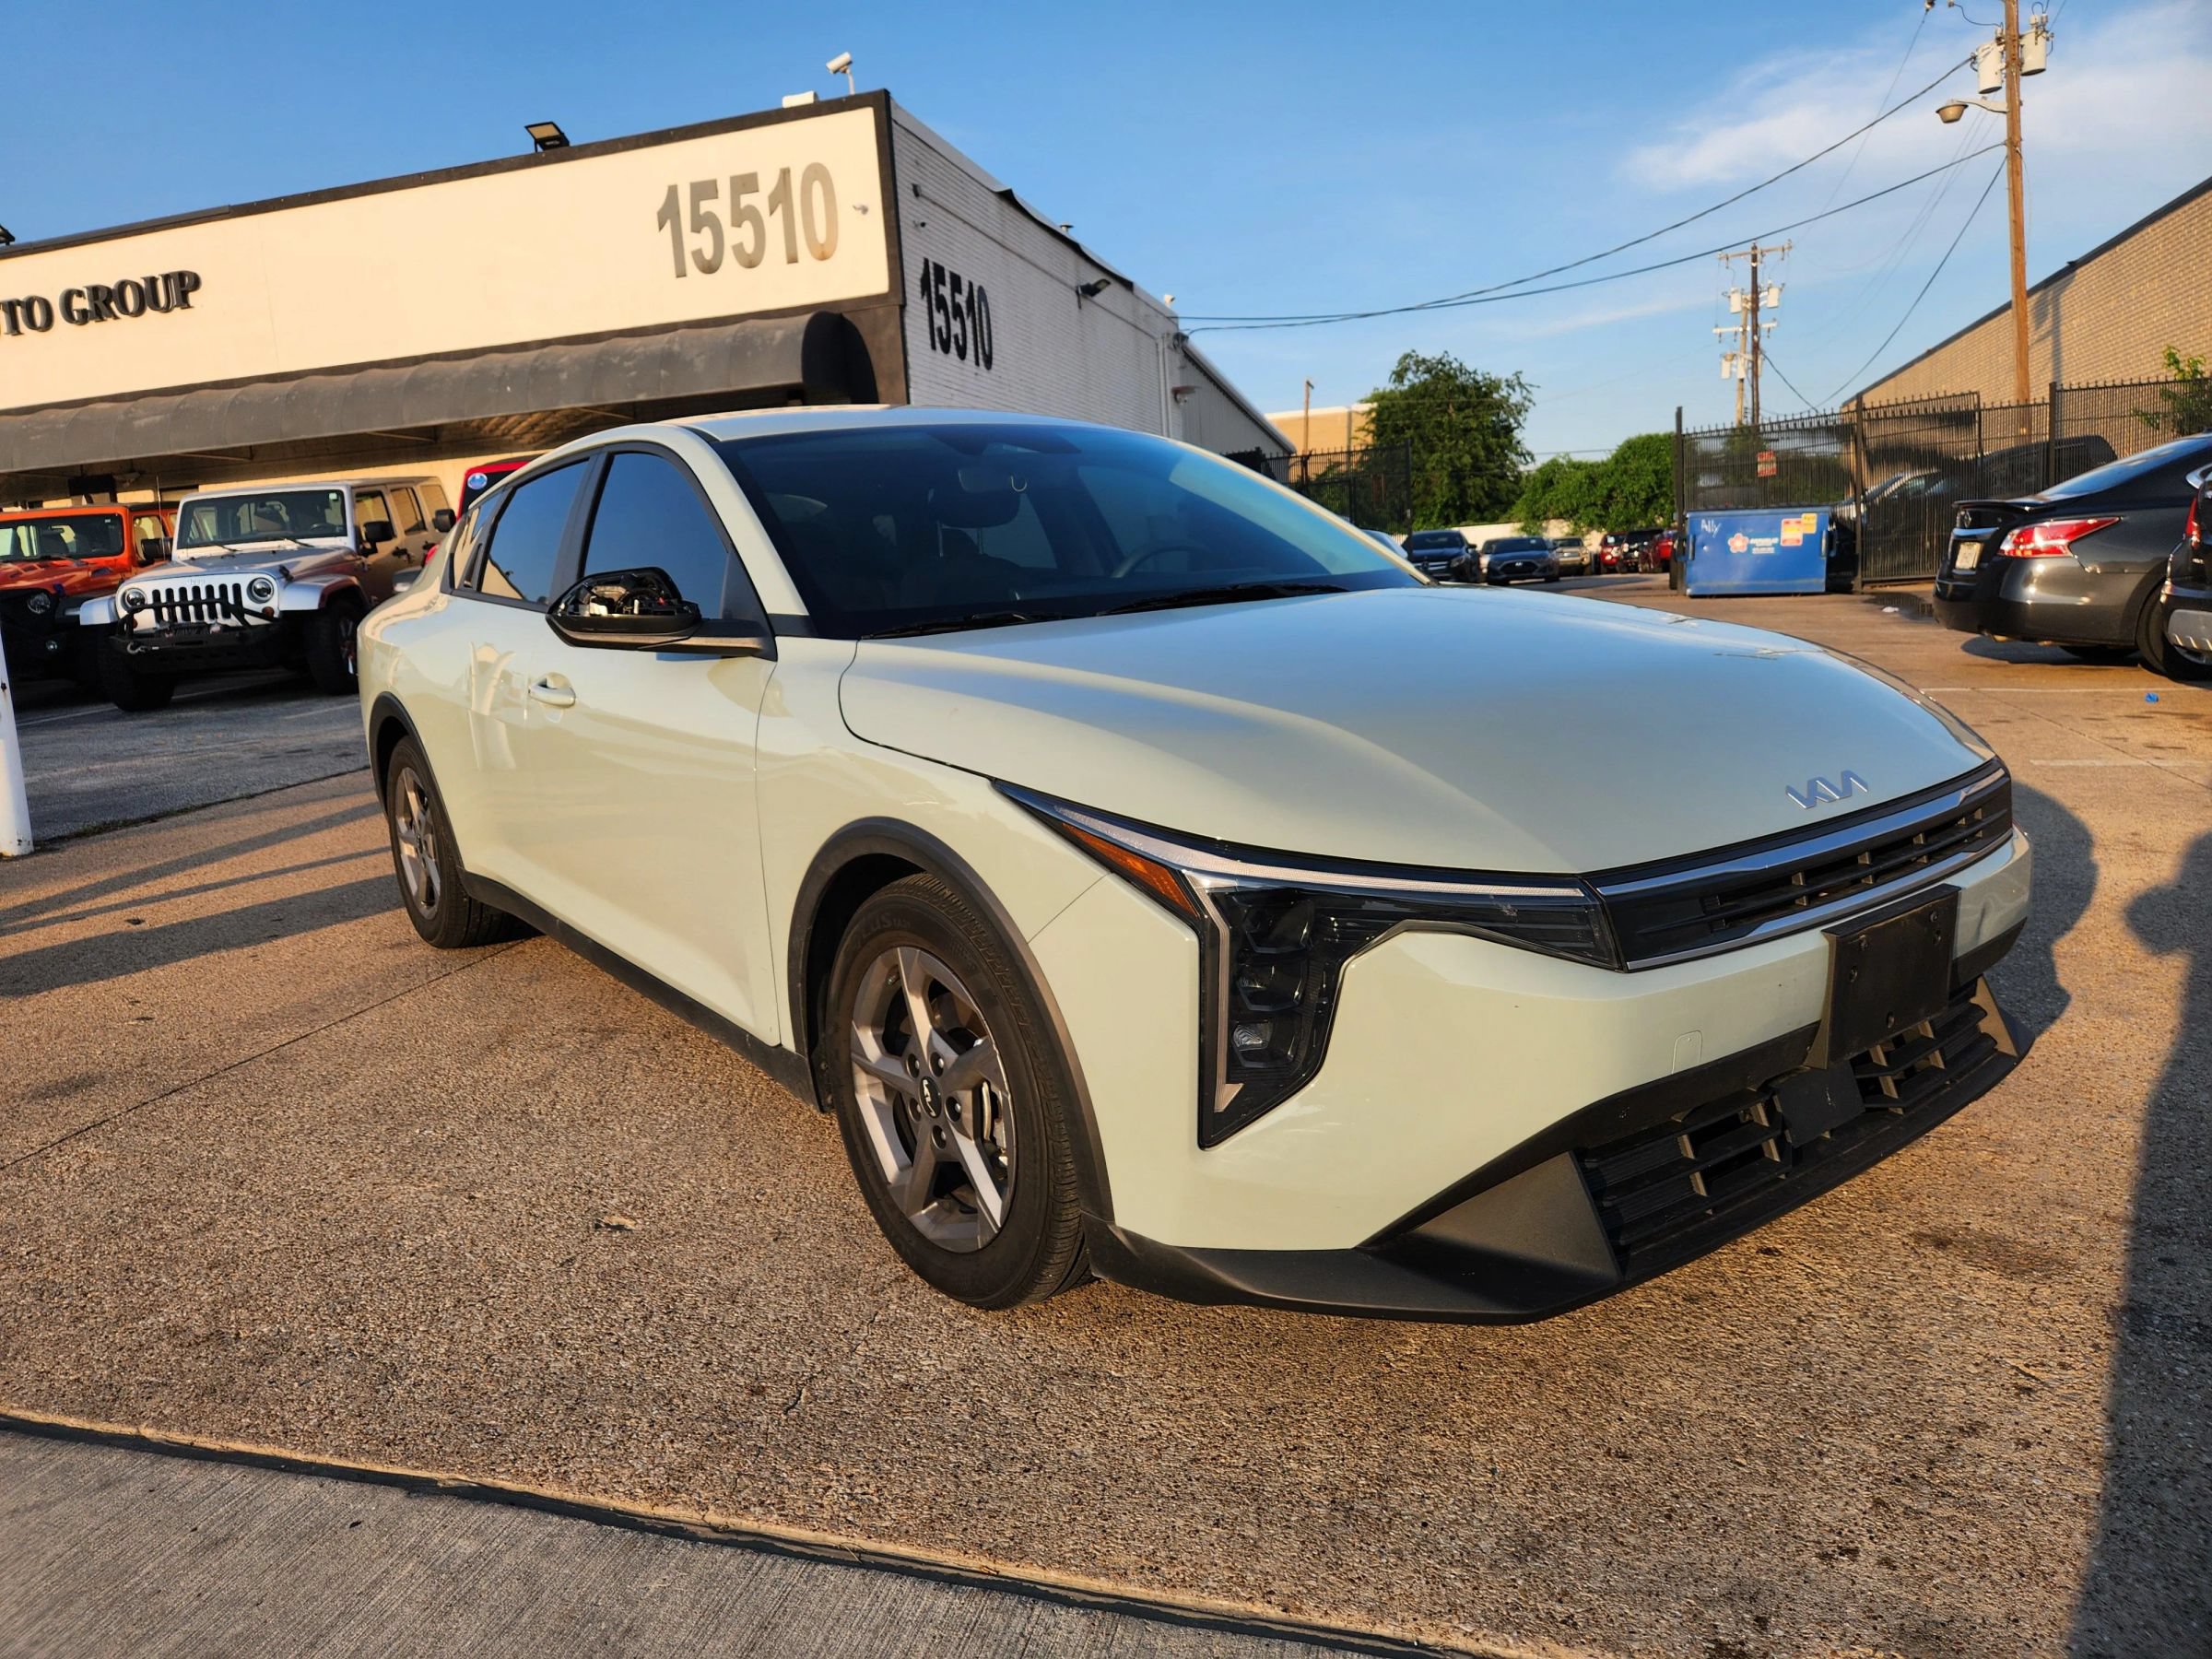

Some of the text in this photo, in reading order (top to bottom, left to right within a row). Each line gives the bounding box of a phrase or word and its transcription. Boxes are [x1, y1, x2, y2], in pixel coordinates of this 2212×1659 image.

[656, 162, 839, 278] 15510
[0, 270, 202, 335] TO GROUP
[920, 257, 993, 371] 15510
